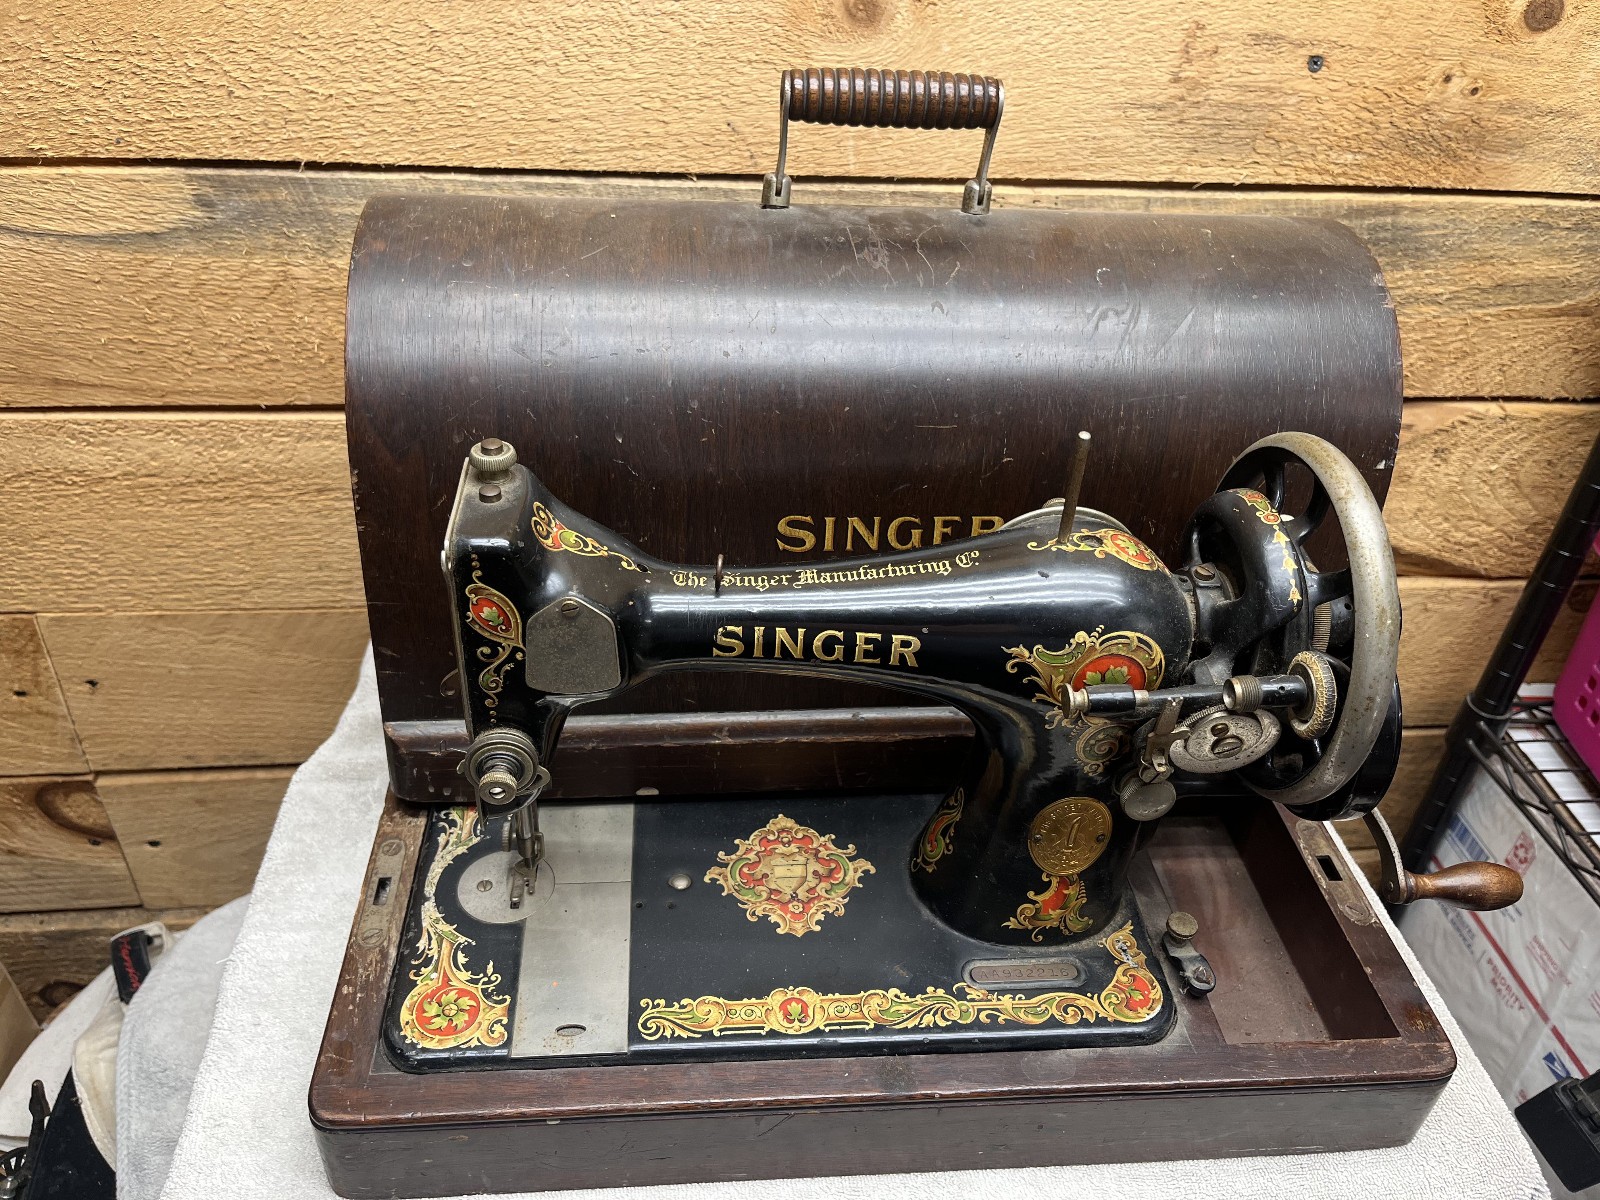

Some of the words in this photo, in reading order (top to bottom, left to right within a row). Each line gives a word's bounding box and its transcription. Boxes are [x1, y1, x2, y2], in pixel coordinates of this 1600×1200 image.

[670, 569, 708, 588] The
[721, 571, 792, 592] Singer
[793, 560, 952, 589] Manufacturing
[712, 625, 921, 668] SINGER
